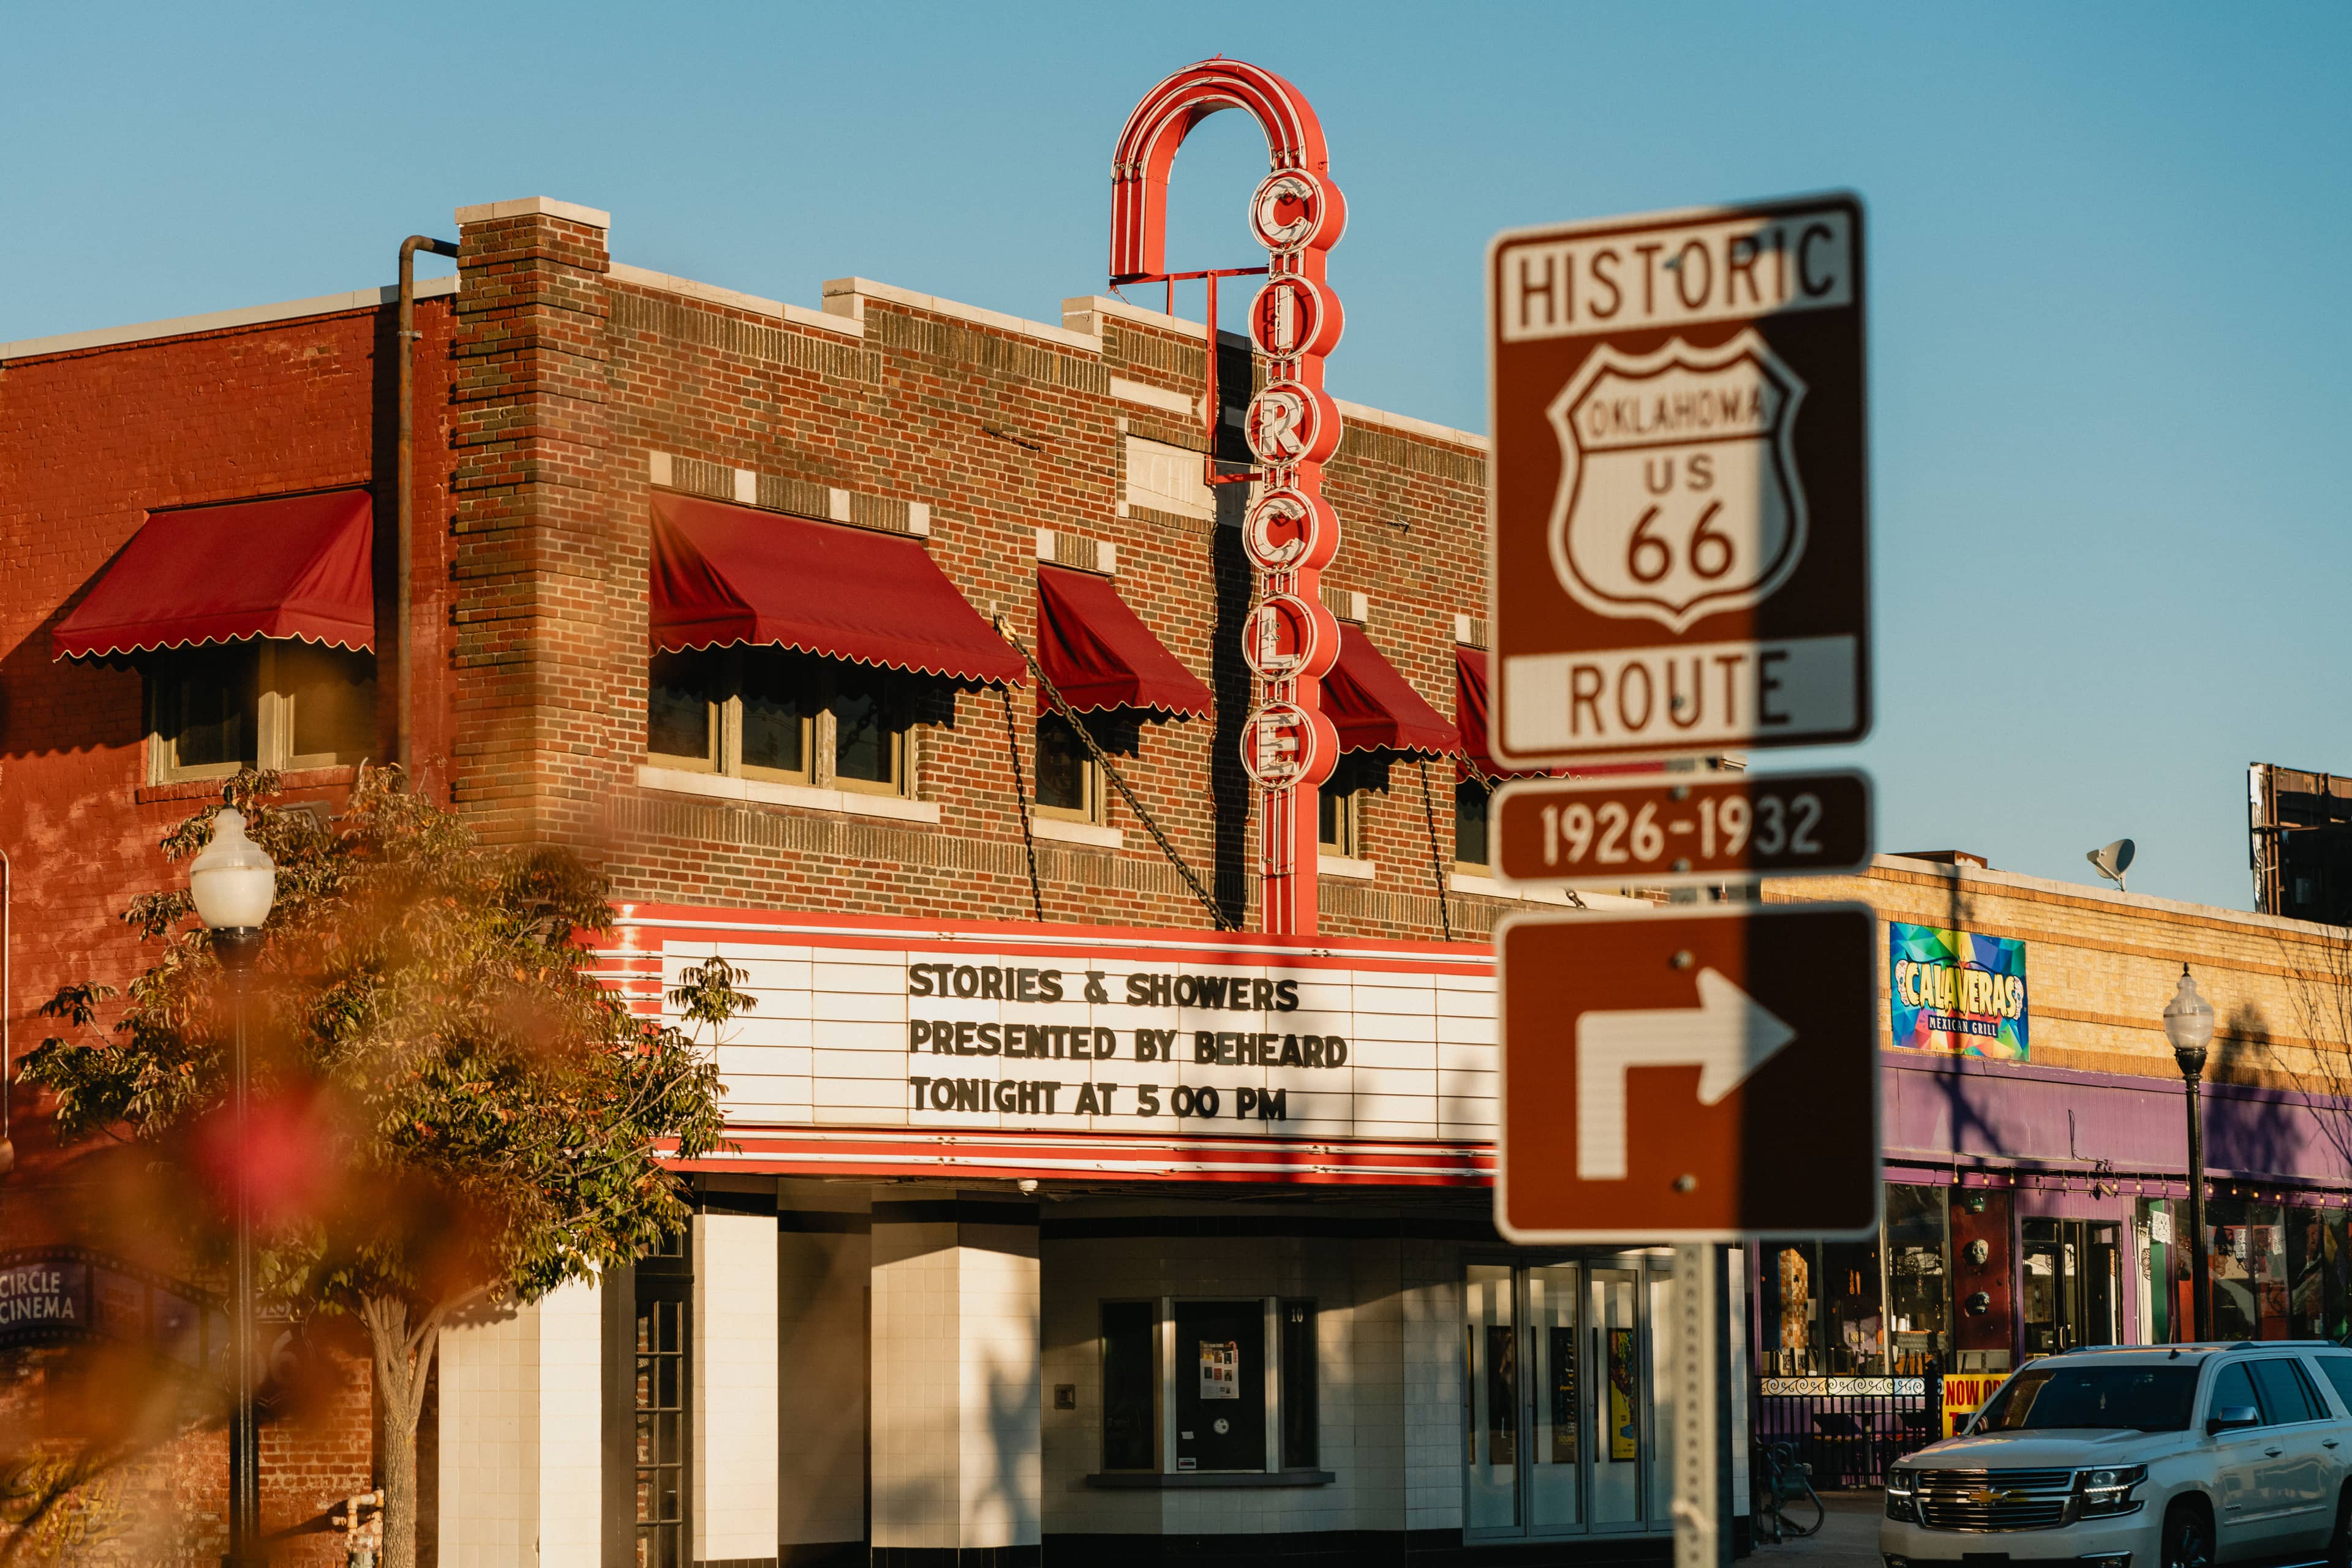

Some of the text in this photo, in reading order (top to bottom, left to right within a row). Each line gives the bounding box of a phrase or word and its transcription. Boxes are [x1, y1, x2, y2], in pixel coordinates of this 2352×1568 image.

[1519, 222, 1833, 328] HISTORIC
[1250, 176, 1313, 778] CIRCLE
[1645, 453, 1715, 495] US
[1627, 499, 1735, 584] 66
[1570, 649, 1793, 736] ROUTE
[1540, 793, 1823, 867] 1926-1932
[910, 963, 1299, 1012] STORIES & SHOWERS
[1905, 962, 2016, 1019] CALAVERAS
[910, 1019, 1348, 1069] PRESENTED BY BEHEARD
[1929, 1017, 1997, 1036] MEXICAN GRILL
[910, 1076, 1061, 1115] TONIGHT
[1075, 1082, 1117, 1116] AT
[1237, 1087, 1286, 1121] PM
[0, 1271, 60, 1298] CIRCLE
[0, 1296, 75, 1324] CINEMA
[1291, 1308, 1303, 1322] 10
[1945, 1380, 1980, 1406] NOW
